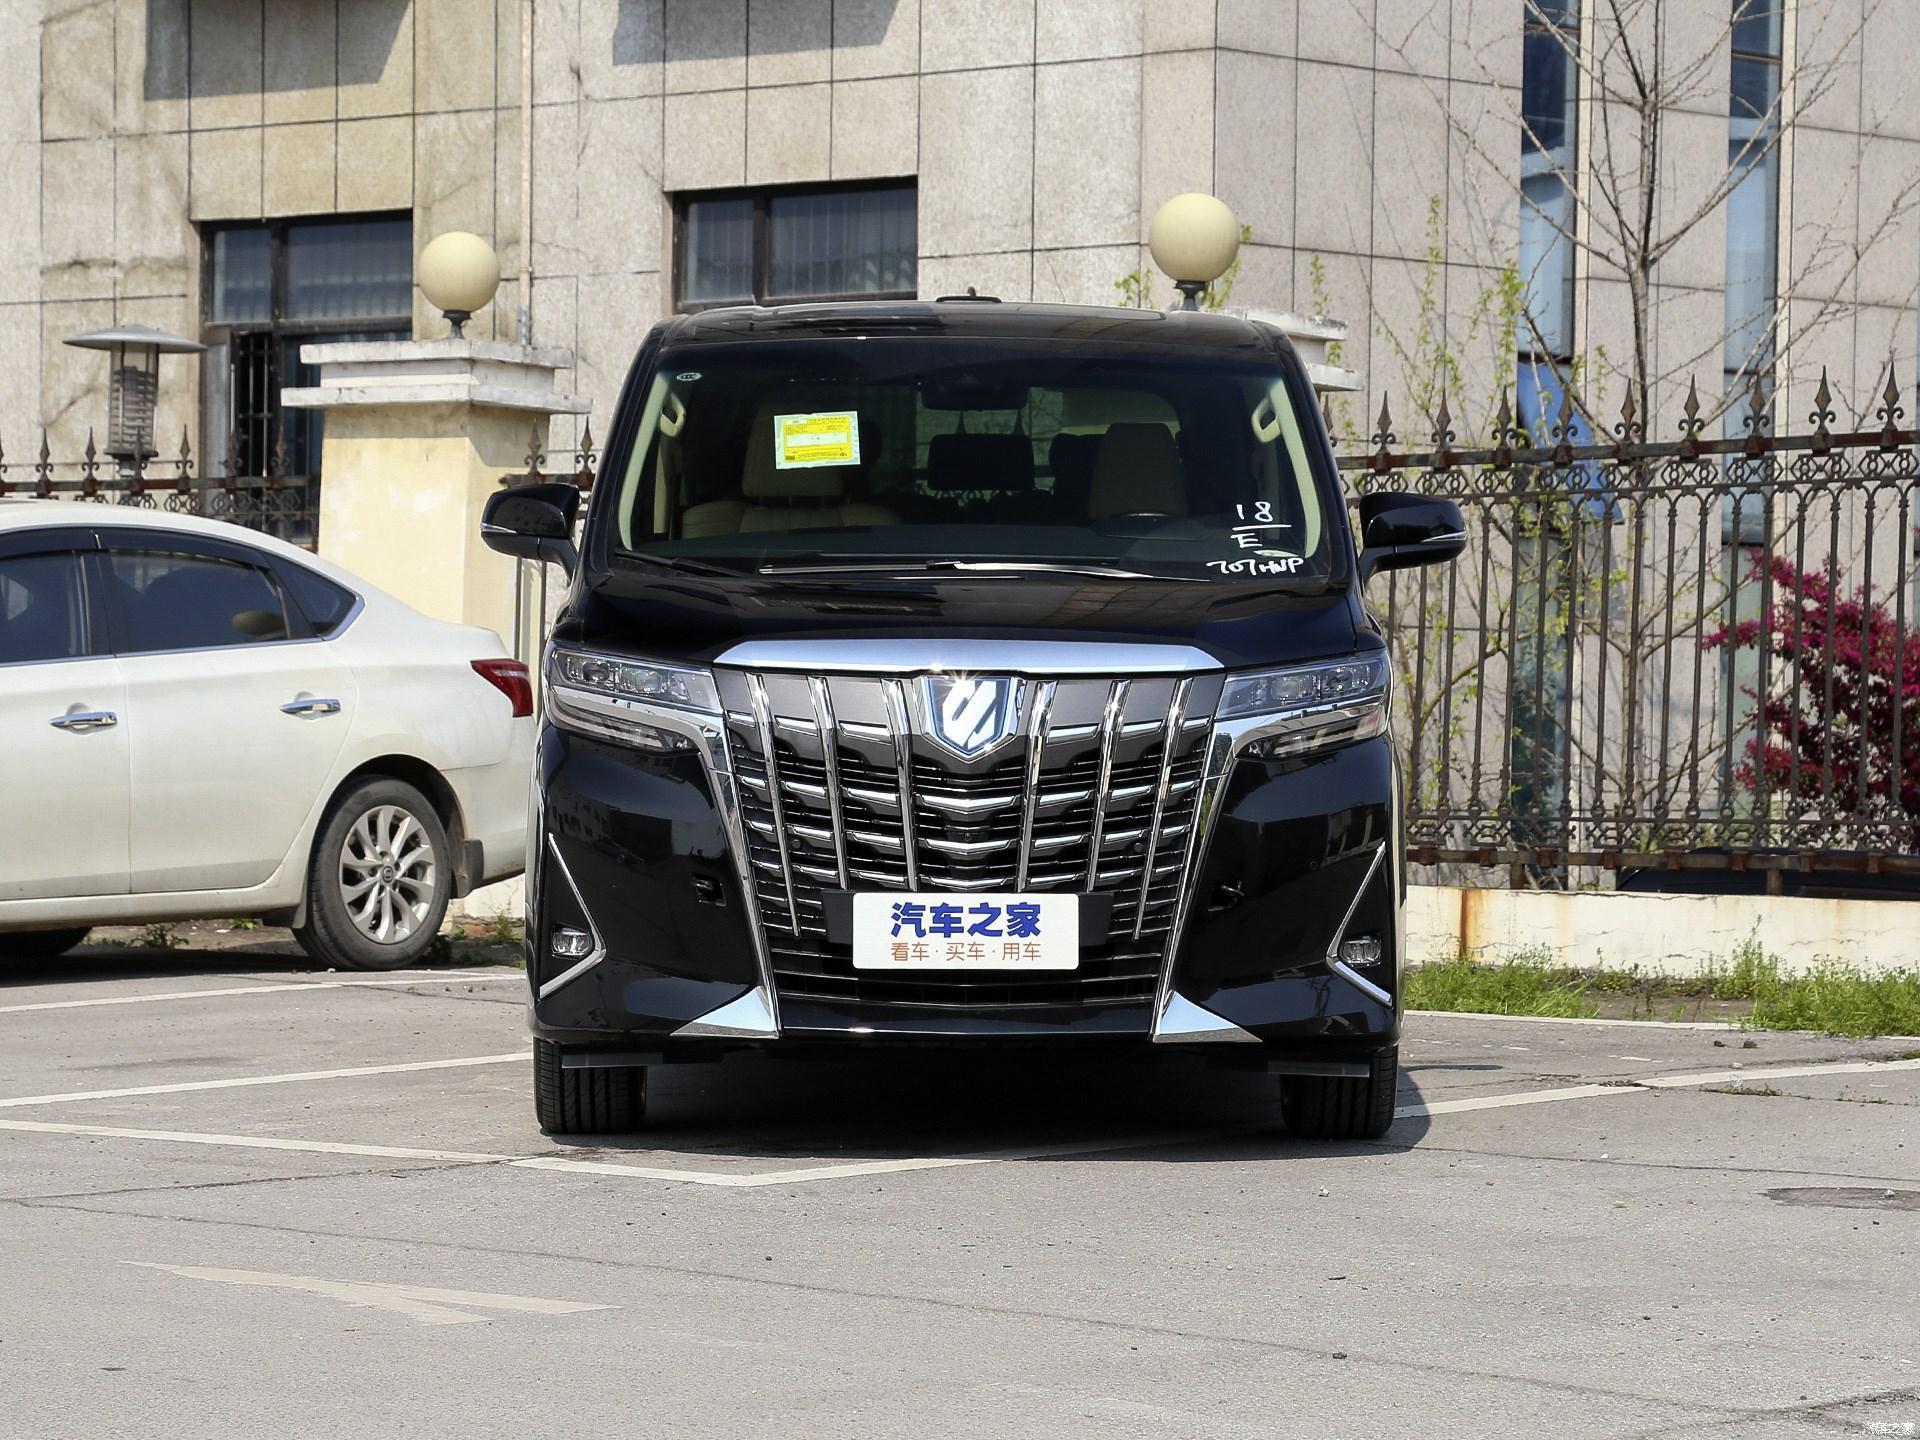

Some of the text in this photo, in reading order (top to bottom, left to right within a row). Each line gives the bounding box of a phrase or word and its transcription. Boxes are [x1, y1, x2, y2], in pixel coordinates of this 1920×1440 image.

[1230, 532, 1263, 549] E
[890, 902, 1041, 938] 汽车之家
